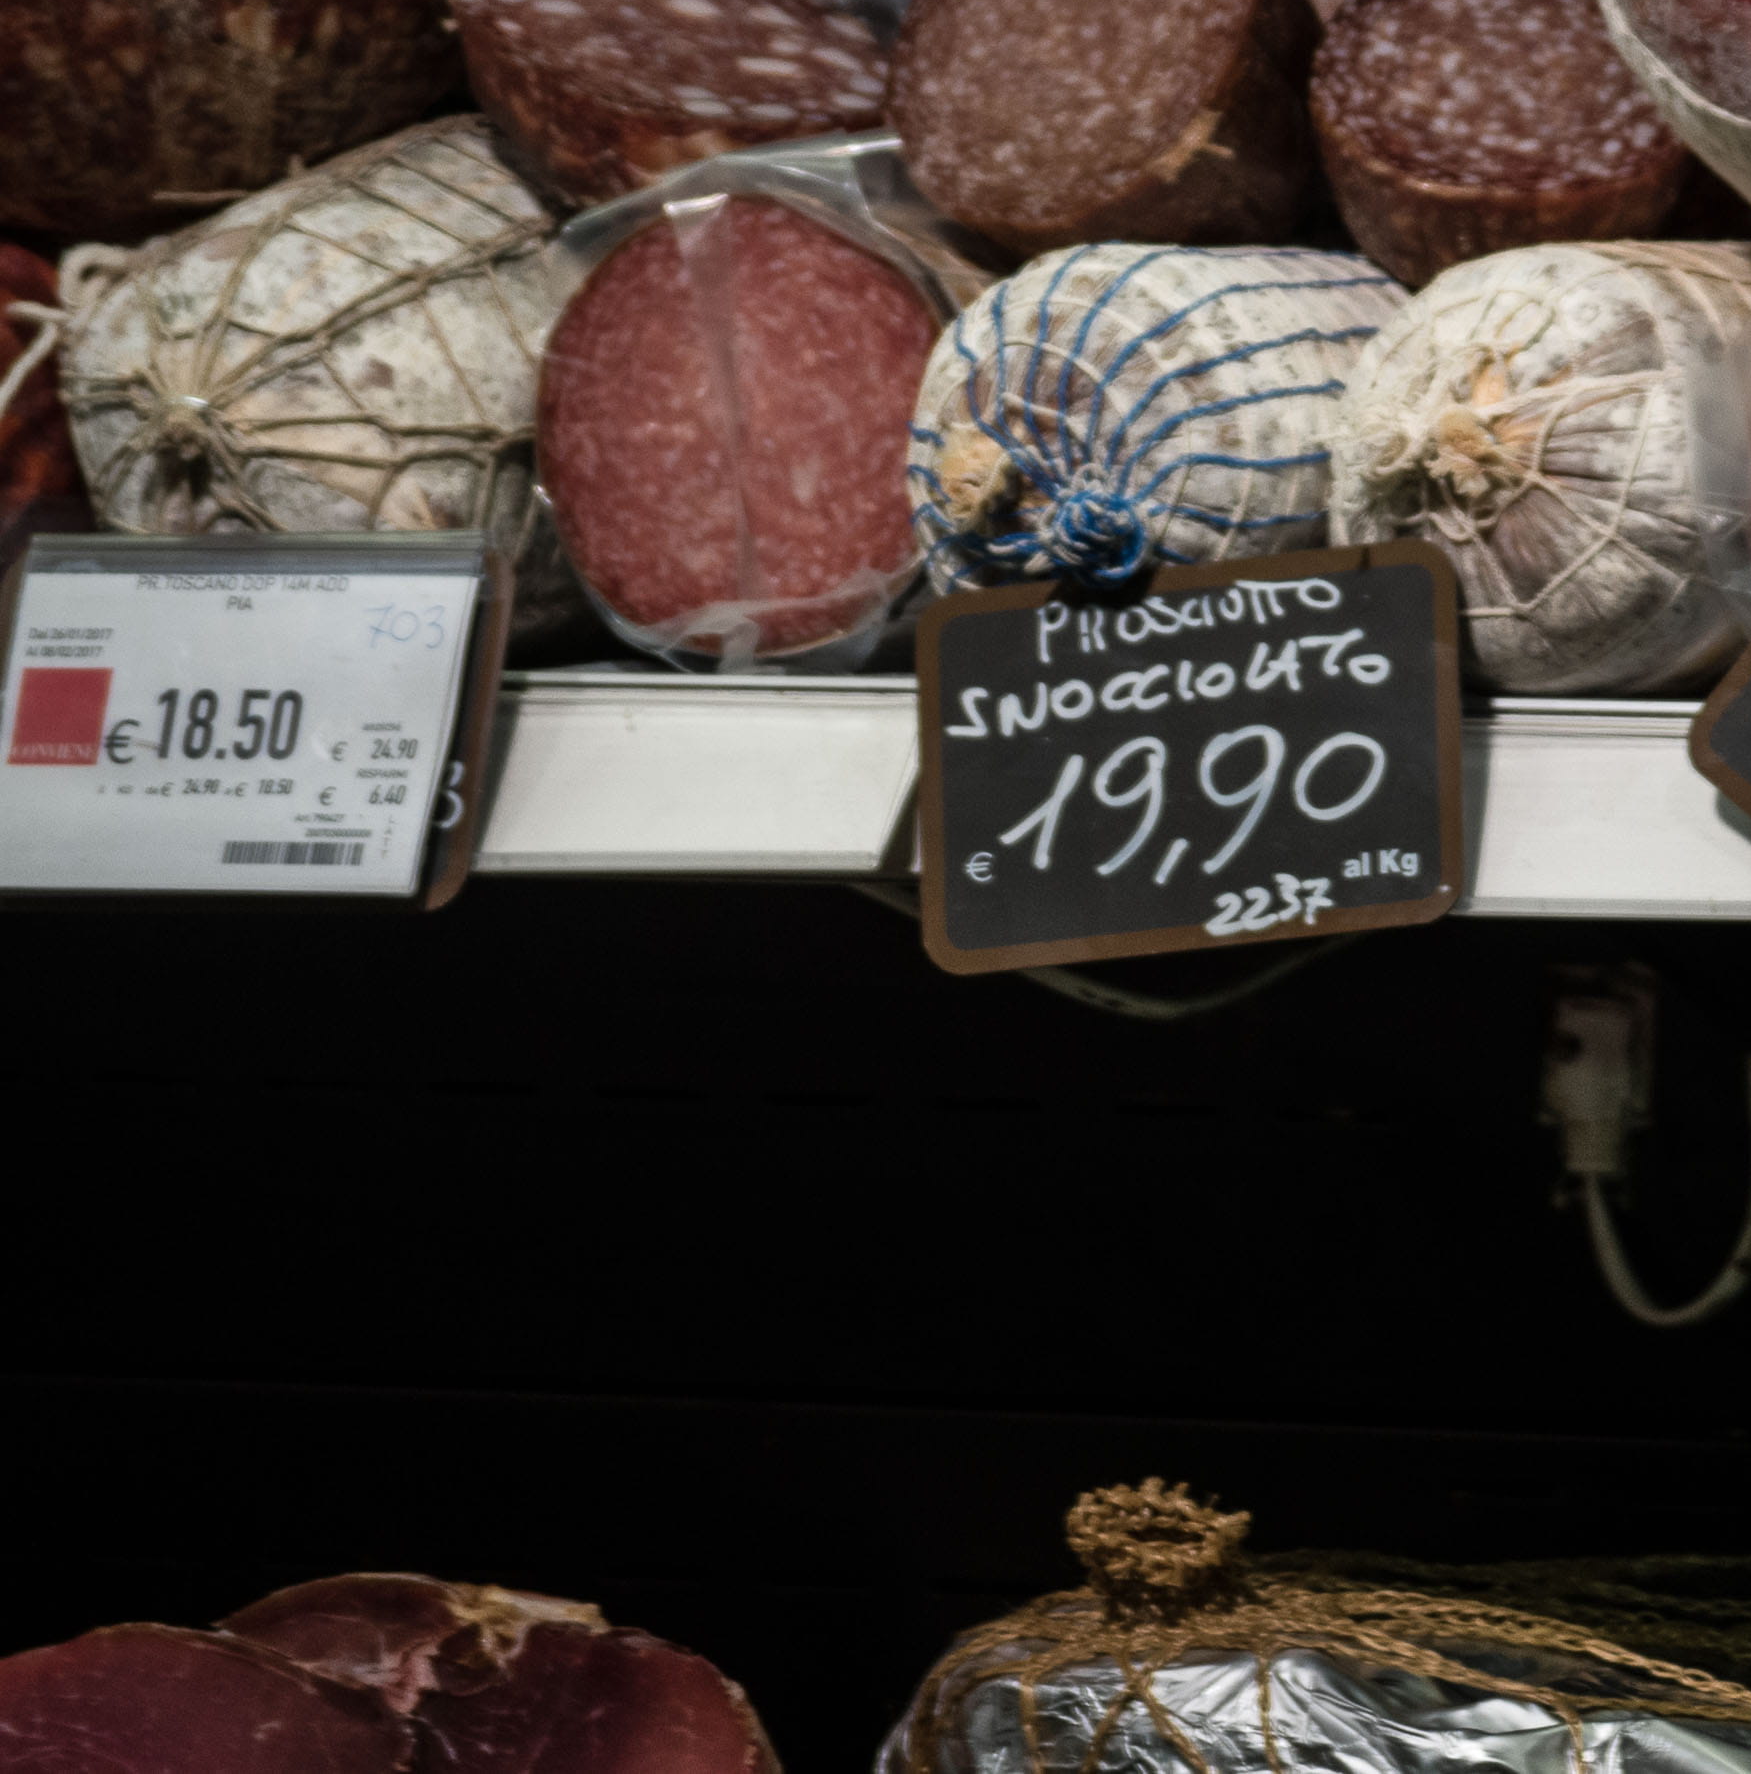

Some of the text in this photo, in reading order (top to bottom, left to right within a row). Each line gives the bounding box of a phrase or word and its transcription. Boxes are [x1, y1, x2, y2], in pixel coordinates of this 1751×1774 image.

[366, 602, 447, 651] 703
[946, 629, 1391, 737] SNOCCIOLATO
[105, 688, 304, 765] € 18.50
[331, 737, 419, 762] € 24.90
[183, 779, 220, 796] 24.90
[258, 779, 294, 796] 18.50
[318, 783, 407, 806] € 6.40
[965, 725, 1386, 885] € 19,90
[1344, 850, 1420, 878] al Kg
